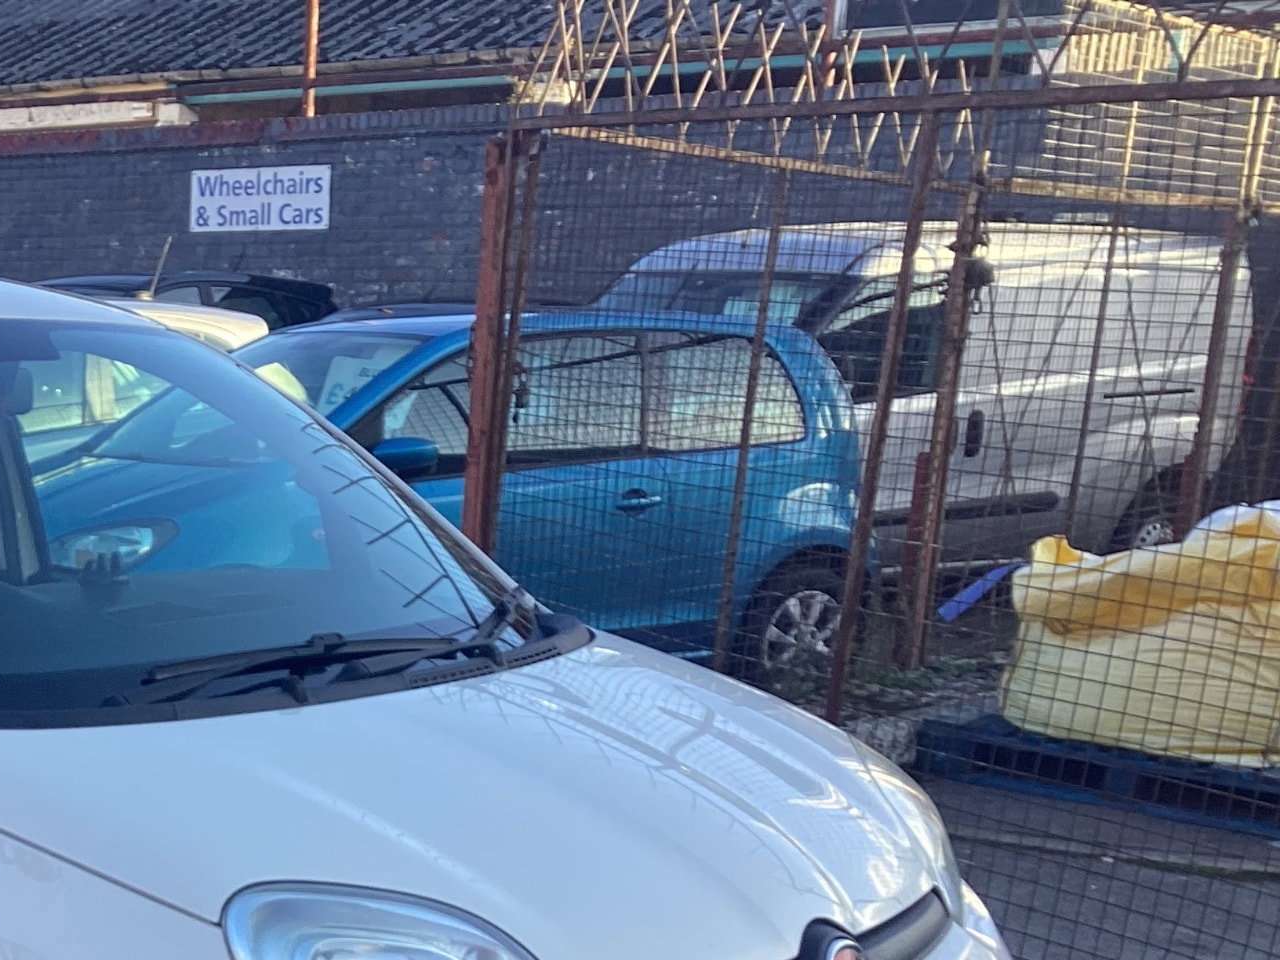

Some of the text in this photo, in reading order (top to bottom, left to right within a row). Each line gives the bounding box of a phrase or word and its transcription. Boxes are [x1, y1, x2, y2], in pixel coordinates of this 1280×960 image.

[197, 170, 323, 197] Wheelchairs
[196, 202, 324, 227] & Small Cars
